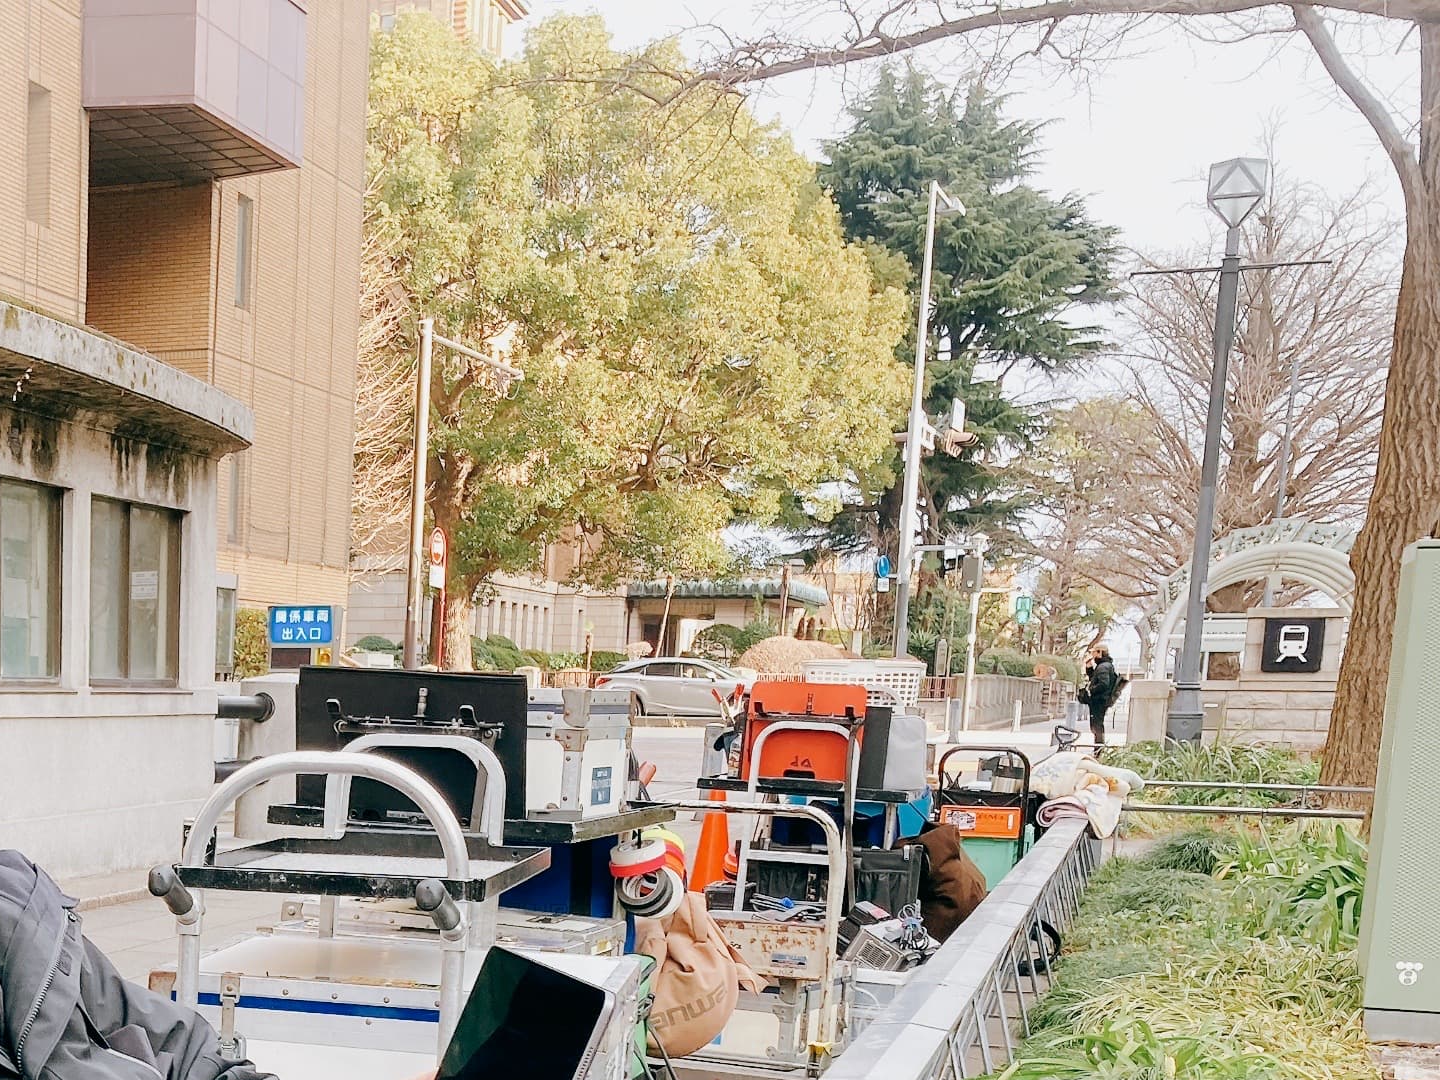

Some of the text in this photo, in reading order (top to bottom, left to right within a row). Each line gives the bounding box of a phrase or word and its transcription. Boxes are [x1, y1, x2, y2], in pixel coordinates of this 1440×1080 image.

[275, 609, 329, 624] 関係車両
[281, 627, 321, 640] 出入口
